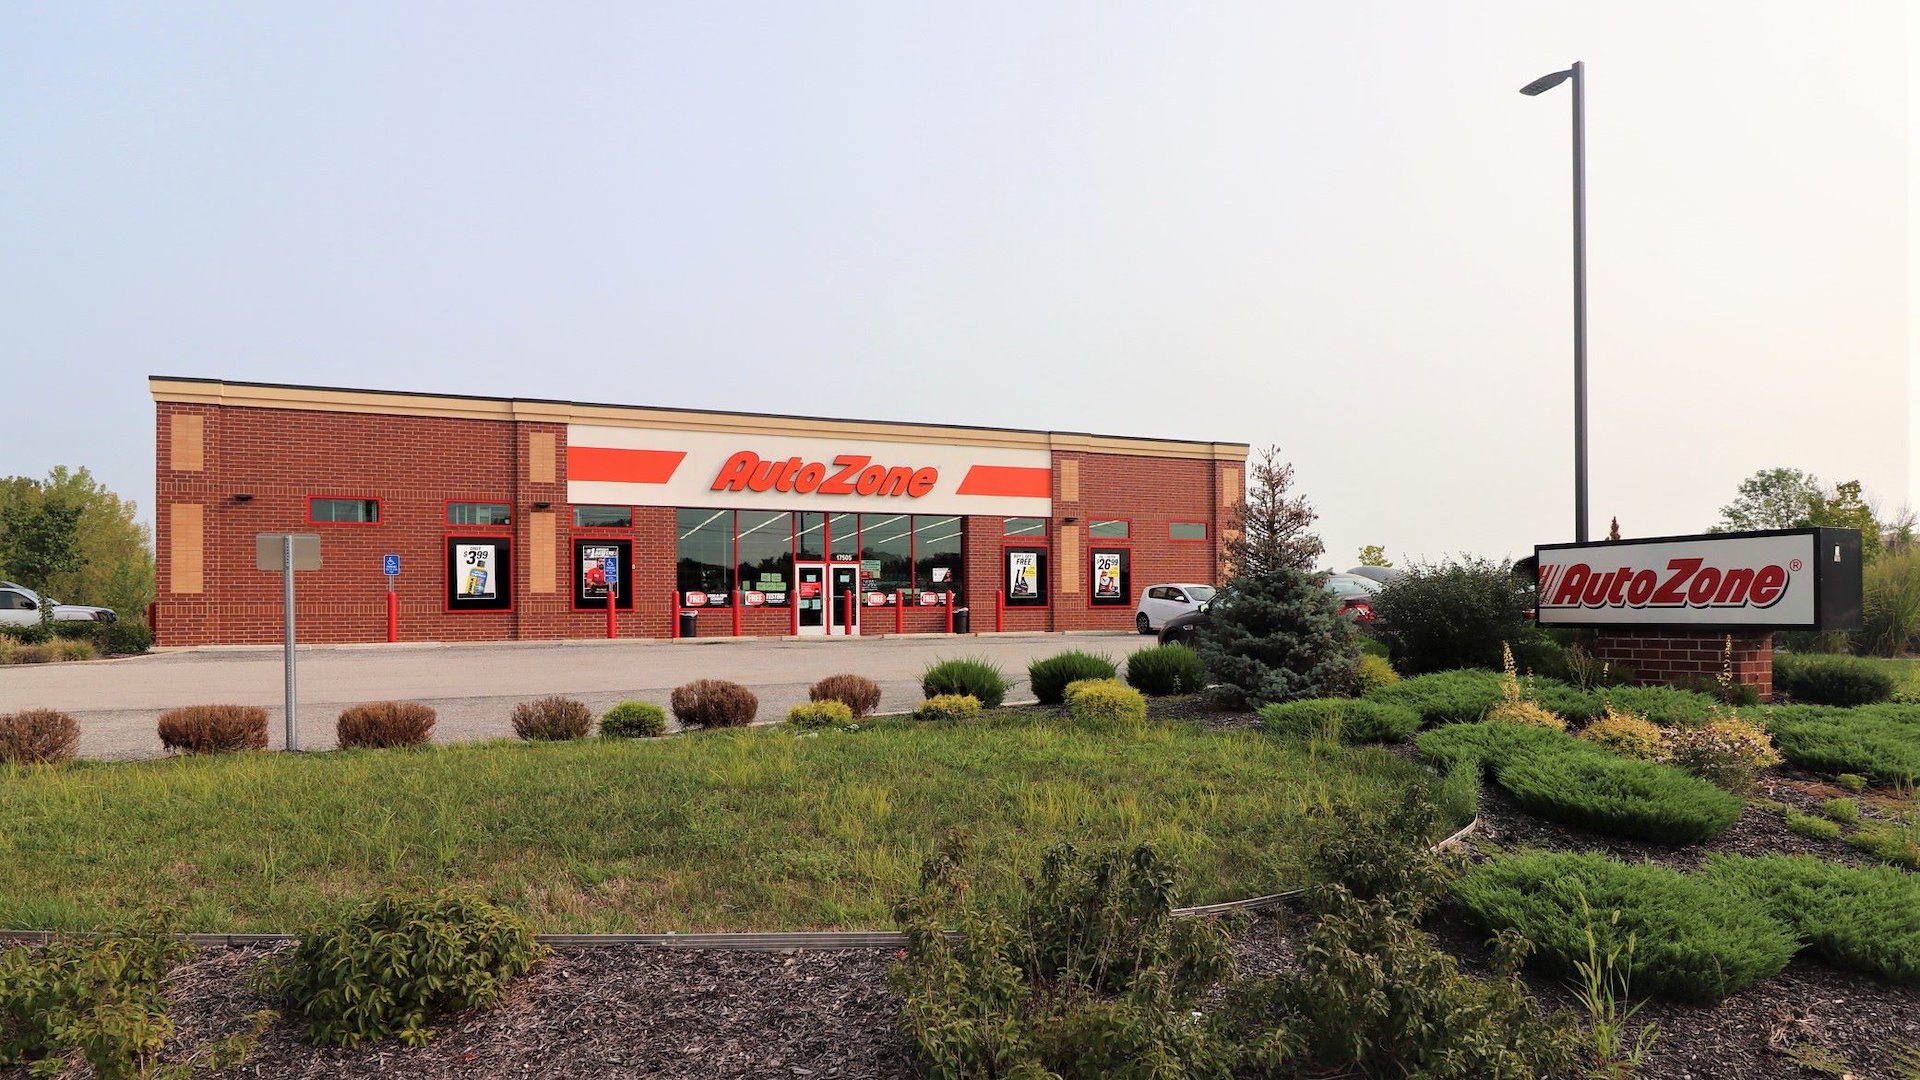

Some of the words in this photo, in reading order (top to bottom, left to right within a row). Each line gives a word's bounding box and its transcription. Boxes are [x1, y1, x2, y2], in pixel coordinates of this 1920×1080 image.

[711, 450, 939, 497] AutoZone
[1551, 557, 1788, 607] AutoZone
[689, 595, 704, 603] FREE
[748, 594, 763, 602] FREE
[871, 595, 884, 603] FREE
[923, 594, 936, 602] FREE
